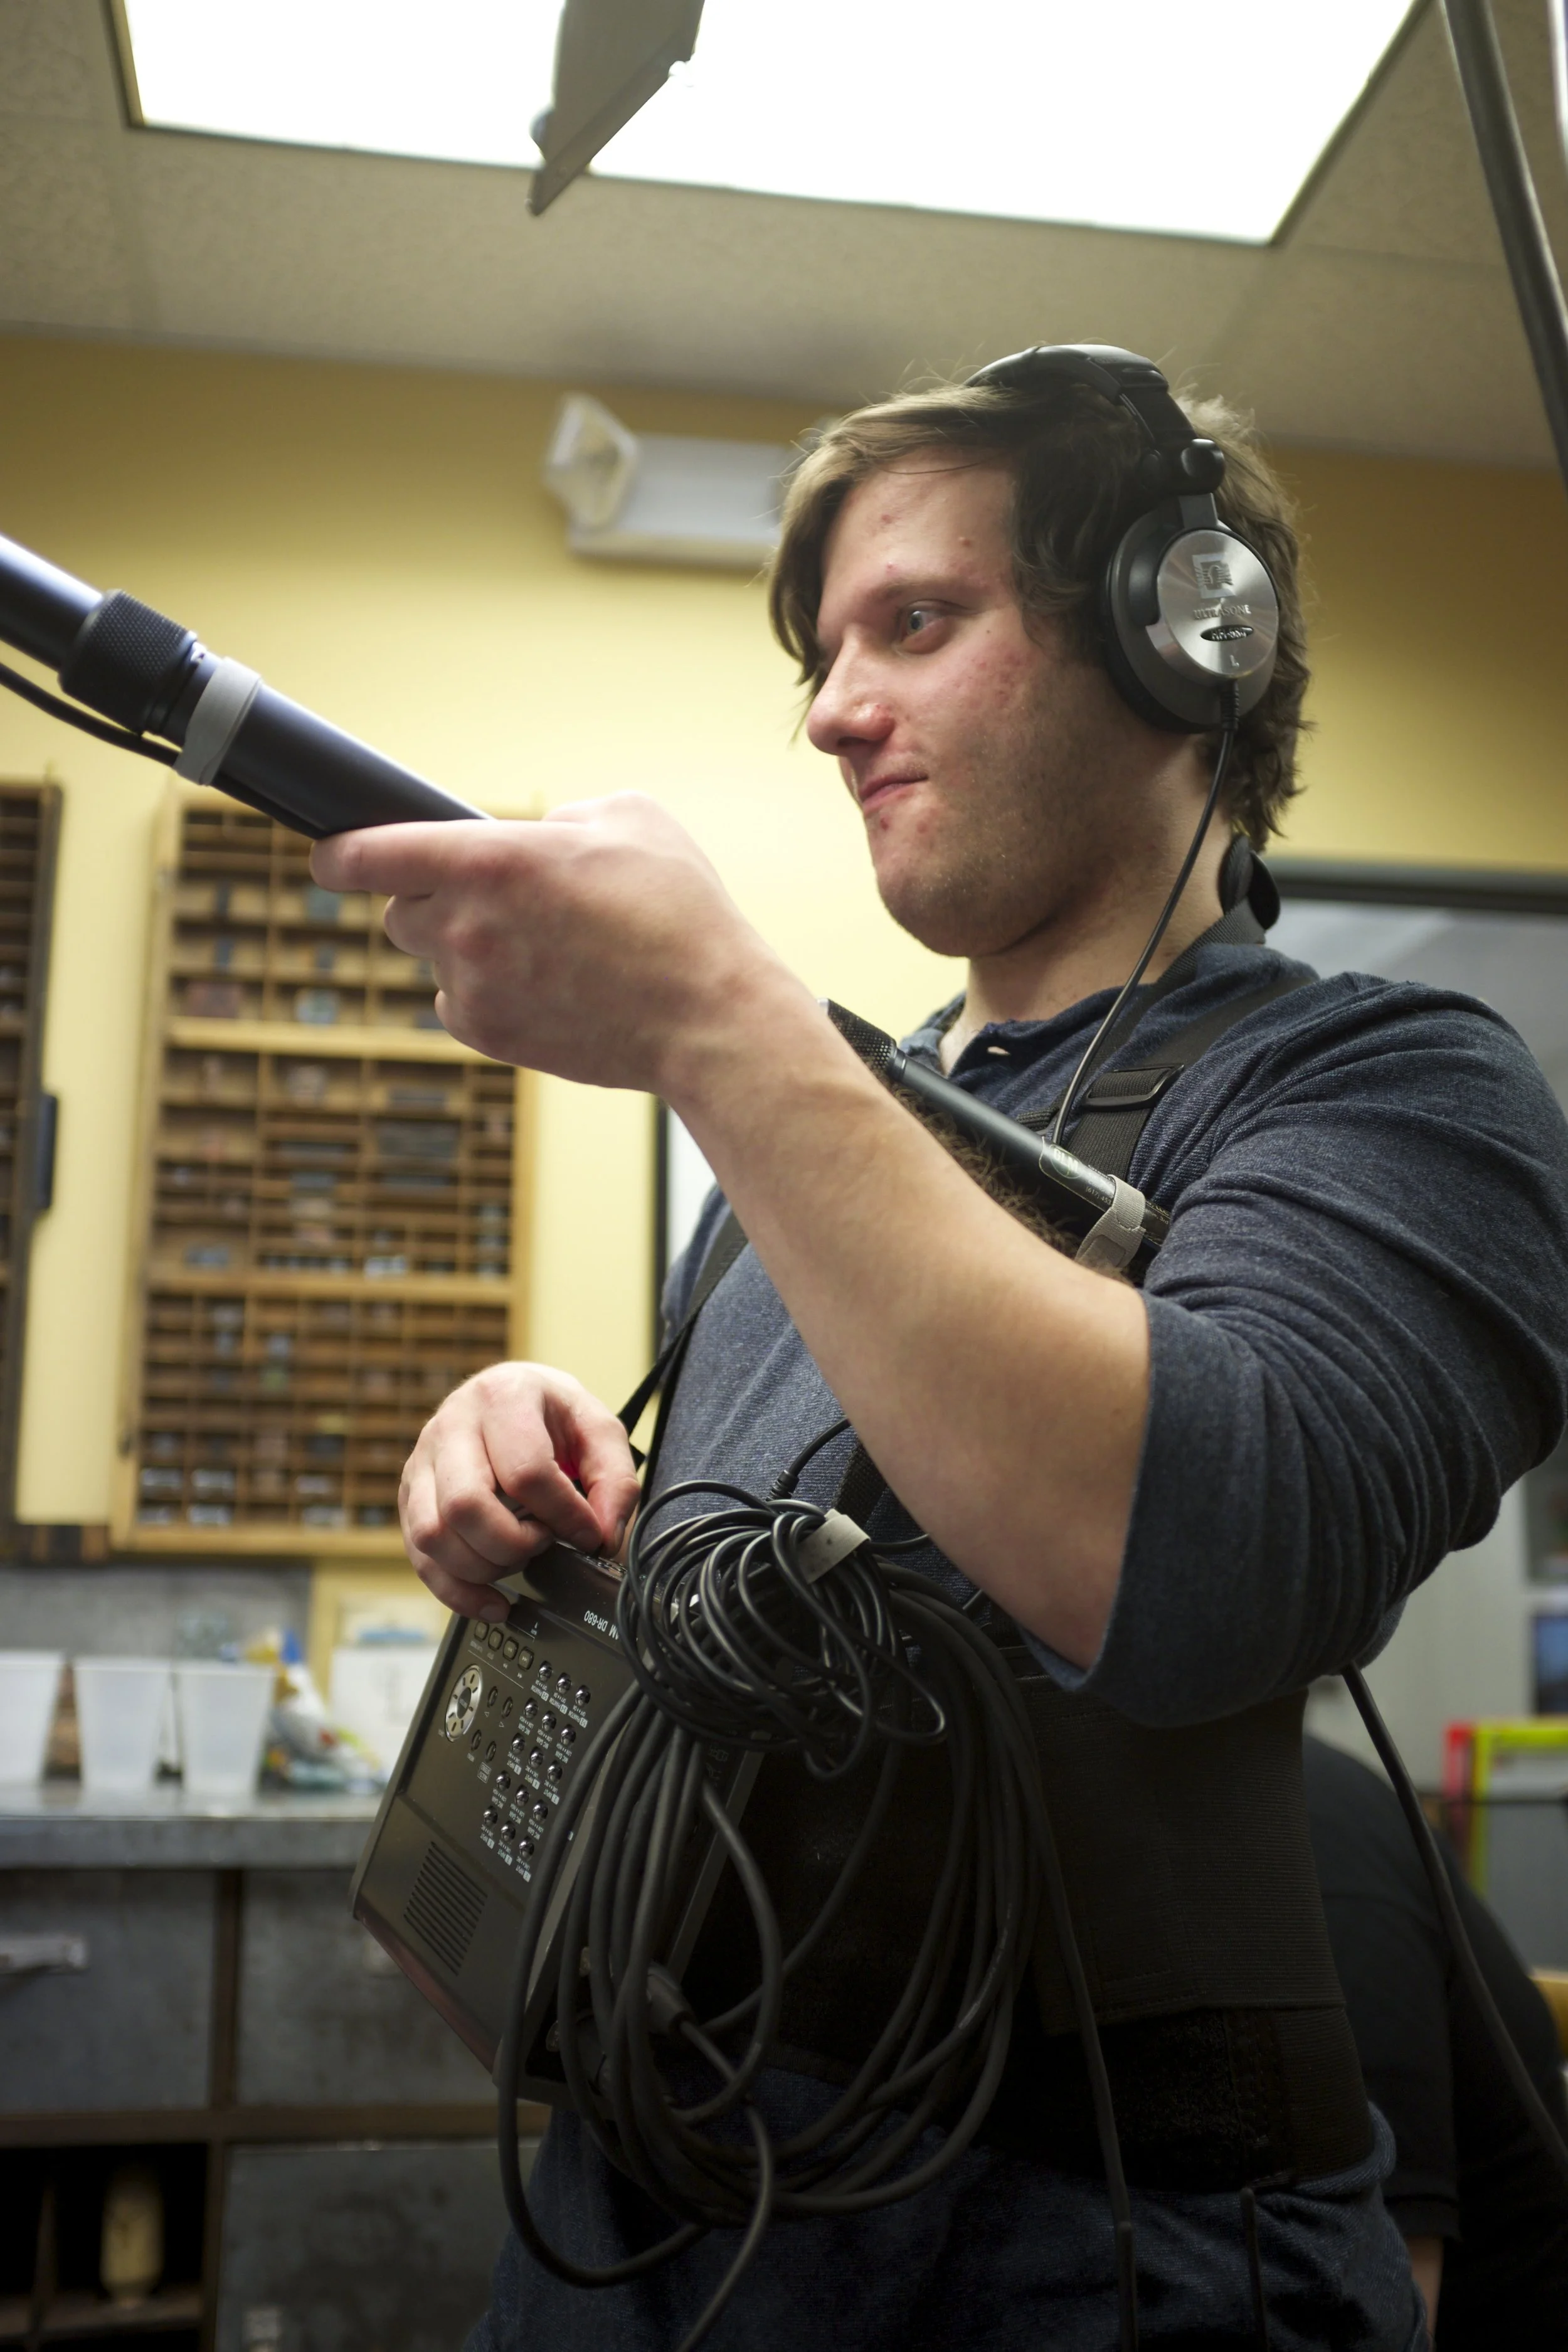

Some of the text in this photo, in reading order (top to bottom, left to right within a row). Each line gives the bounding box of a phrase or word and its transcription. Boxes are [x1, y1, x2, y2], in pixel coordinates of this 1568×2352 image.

[1193, 605, 1251, 620] ULTRASONE
[1230, 655, 1240, 667] L
[1086, 1186, 1099, 1199] (617)
[584, 1610, 608, 1633] DR-680
[531, 1685, 543, 1696] PHANTOM
[549, 1697, 561, 1709] PHANTOM
[568, 1710, 581, 1723] PHANTOM
[507, 1759, 516, 1769] INPUT
[525, 1774, 533, 1784] INPUT
[544, 1788, 553, 1799] INPUT
[480, 1832, 489, 1843] INPUT
[498, 1848, 506, 1859] INPUT
[516, 1865, 524, 1875] INPUT
